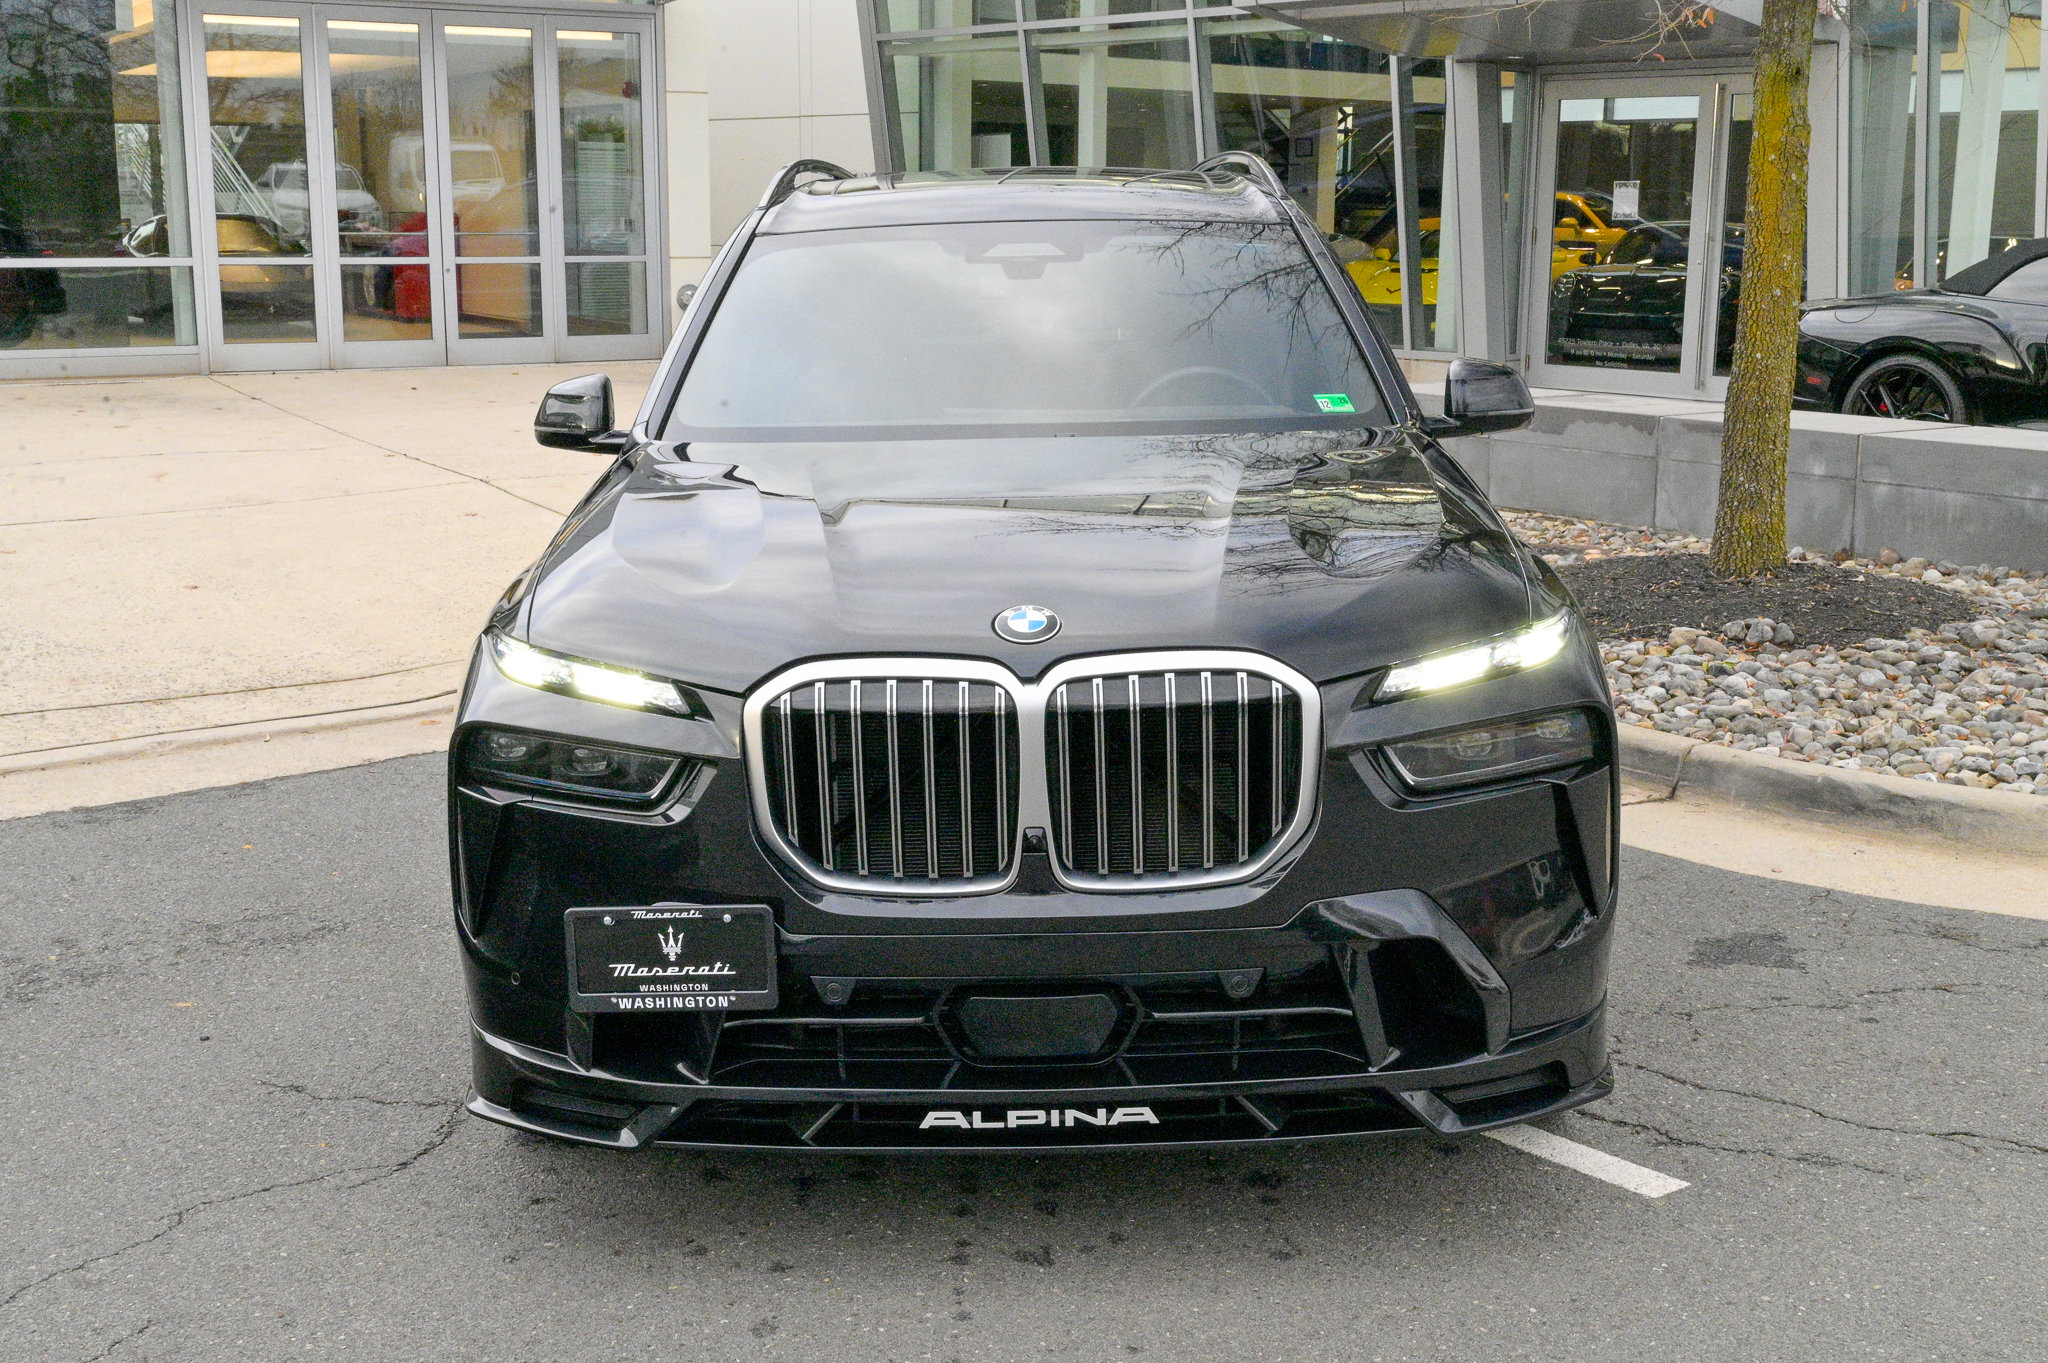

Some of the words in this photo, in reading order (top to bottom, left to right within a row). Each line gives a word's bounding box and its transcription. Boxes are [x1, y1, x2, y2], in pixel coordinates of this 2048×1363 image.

[1320, 400, 1331, 409] 12
[631, 910, 703, 919] Maserati
[609, 961, 736, 977] Maserati
[640, 983, 709, 992] WASHINGTON
[618, 996, 729, 1009] WASHINGTON
[919, 1106, 1160, 1129] ALPINA
